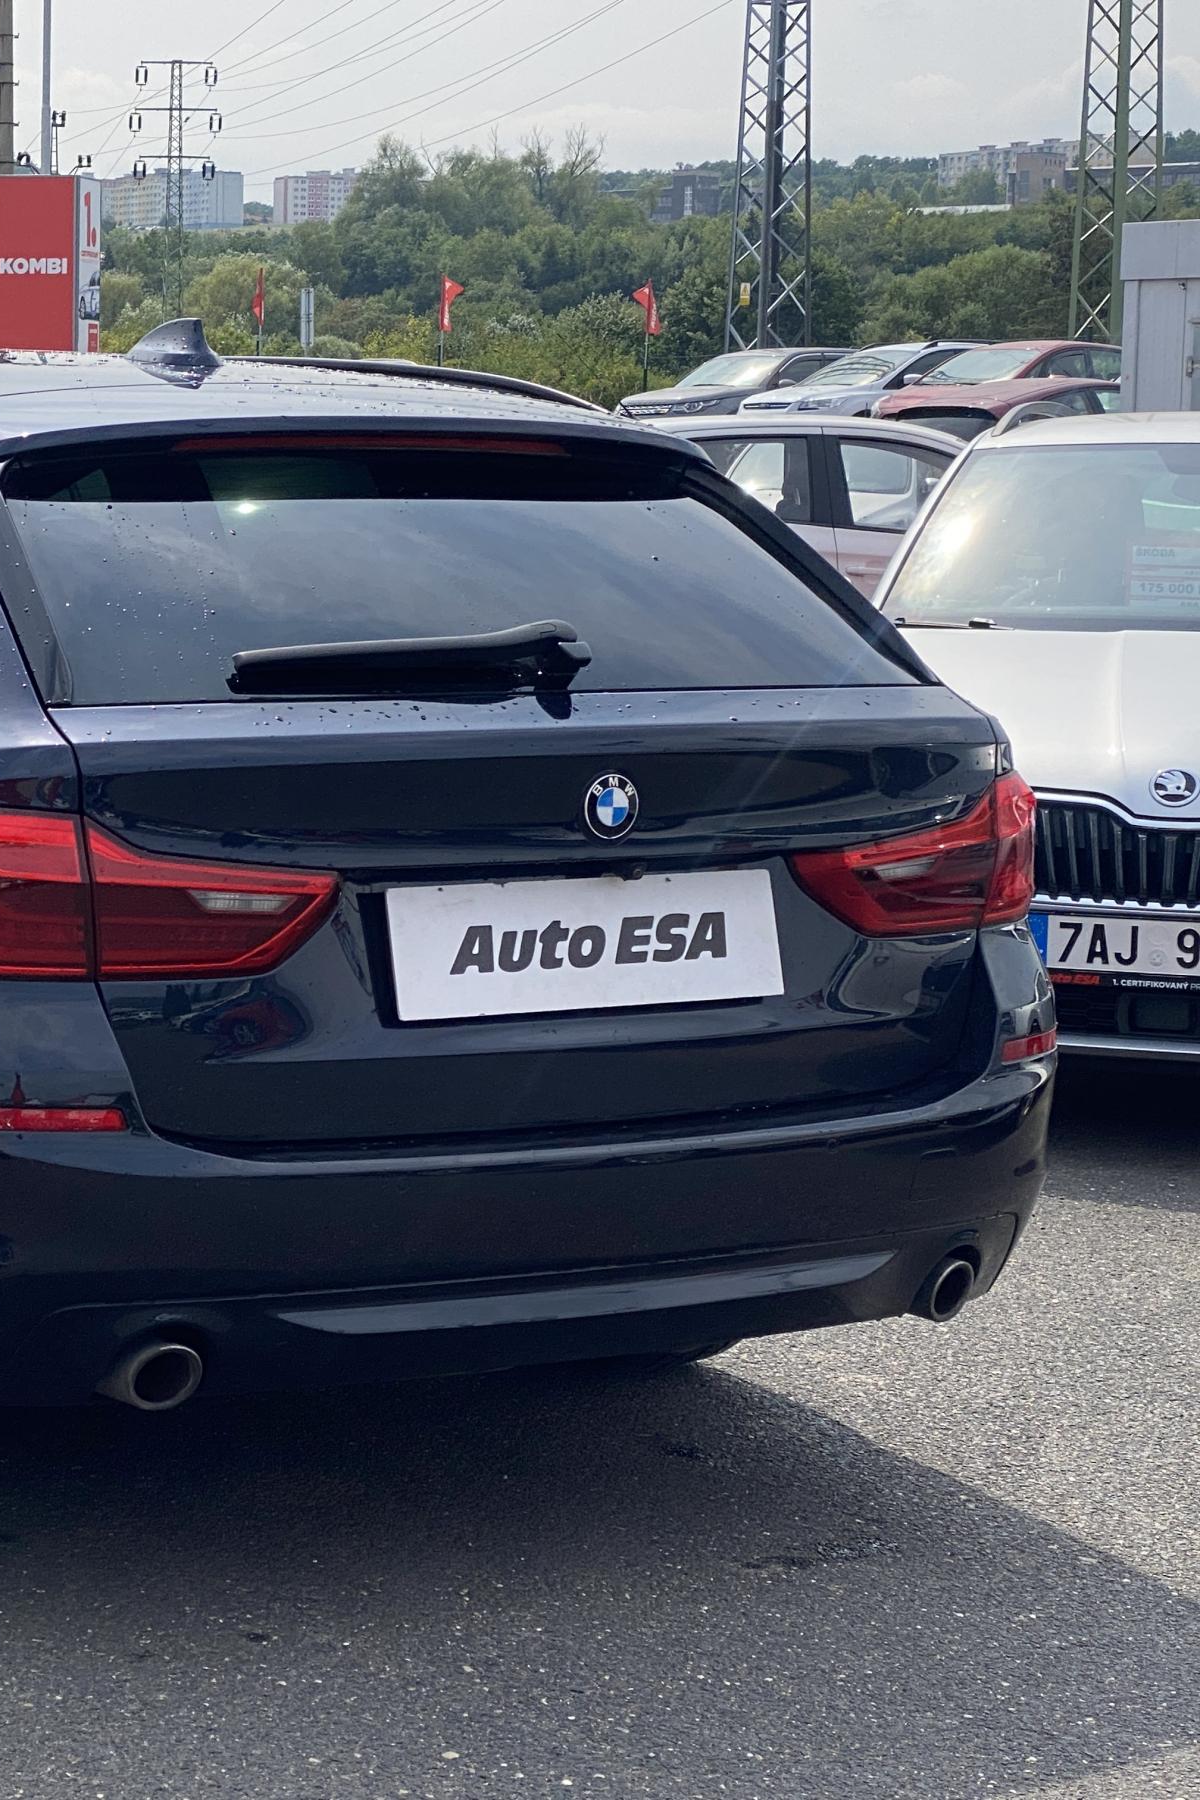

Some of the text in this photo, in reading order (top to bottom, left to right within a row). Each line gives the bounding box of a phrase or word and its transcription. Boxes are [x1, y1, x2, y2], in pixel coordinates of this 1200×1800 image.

[1141, 582, 1194, 594] 175 000
[592, 776, 635, 797] BMW
[450, 911, 727, 975] Auto ESA
[1058, 921, 1139, 966] 7AJ
